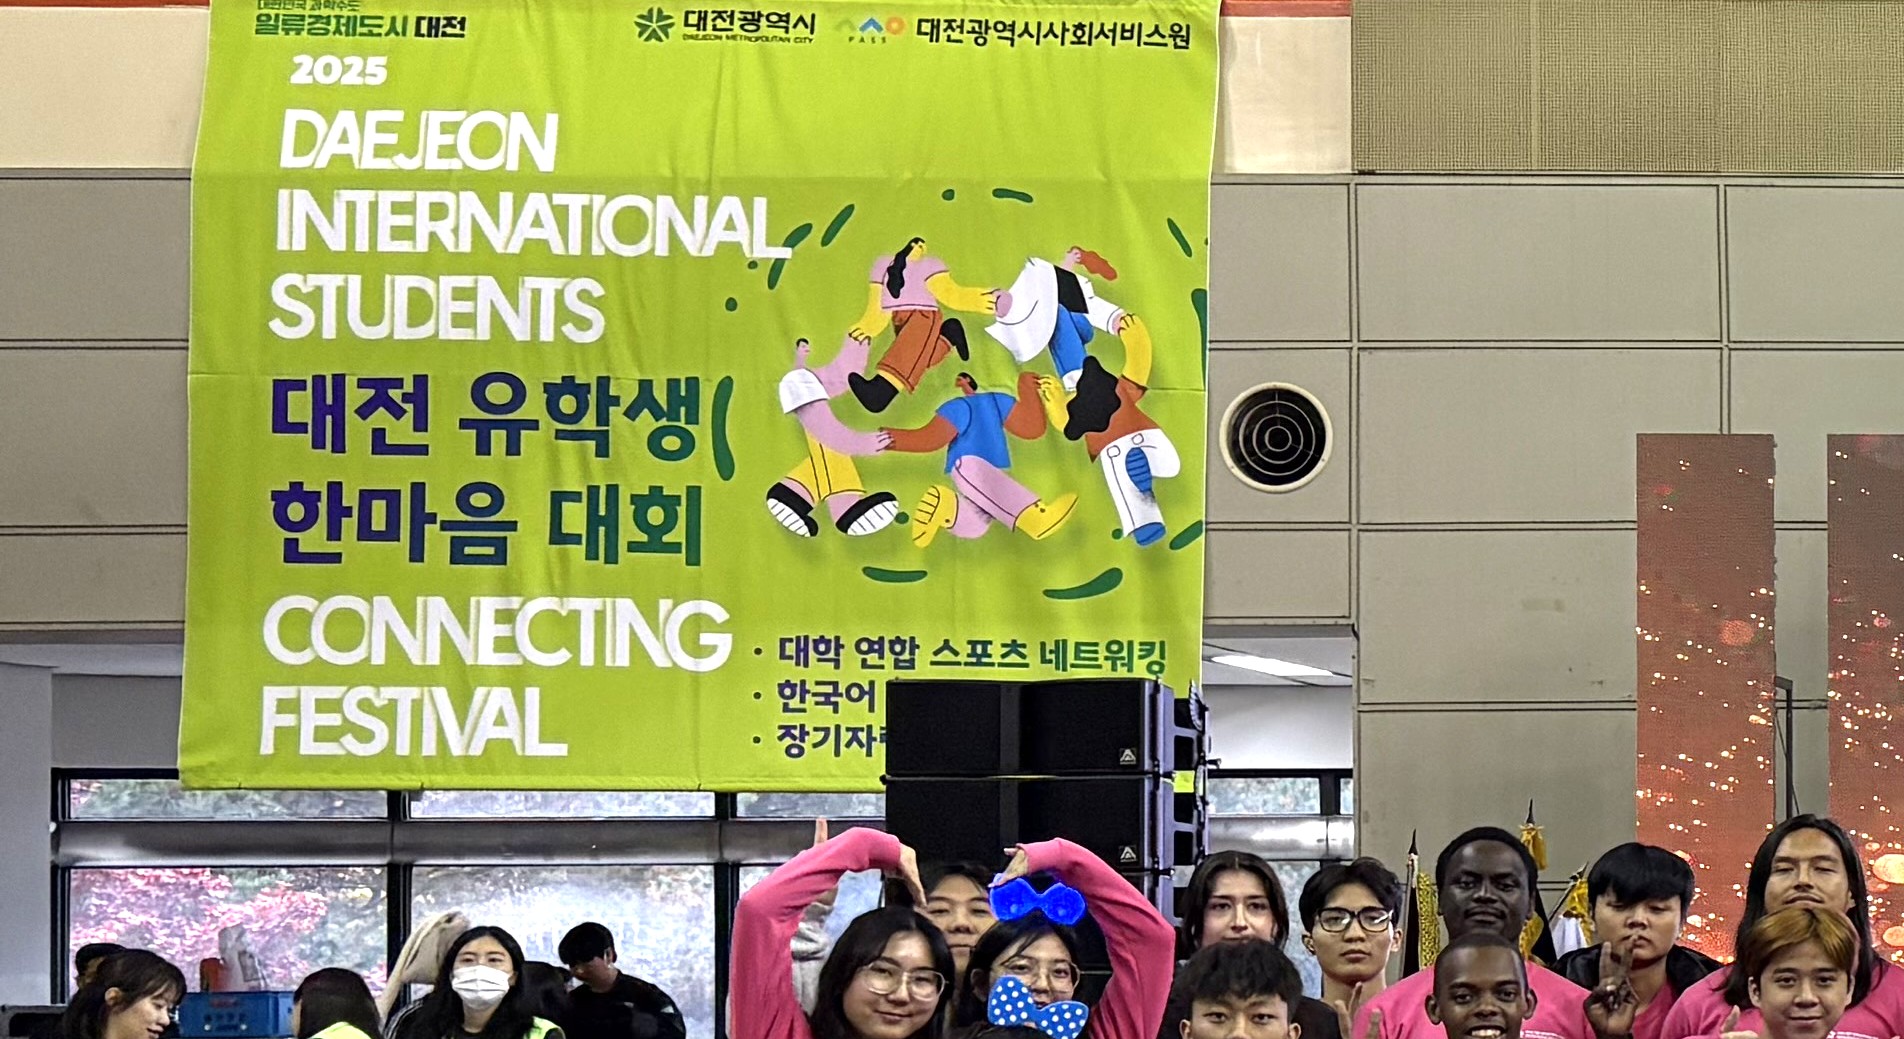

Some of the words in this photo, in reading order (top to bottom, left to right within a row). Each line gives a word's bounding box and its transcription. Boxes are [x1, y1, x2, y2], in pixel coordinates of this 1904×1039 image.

[254, 13, 408, 38] 일류경제도시
[414, 15, 466, 39] 대전
[683, 10, 816, 35] 대전광역시
[916, 17, 1191, 50] 대전광역시사회서비스원
[290, 54, 388, 86] 2025
[280, 108, 559, 172] DAEJEON
[276, 188, 792, 260] INTERNATIONAL
[268, 272, 606, 343] STUDENTS
[272, 373, 429, 457] 대전
[459, 371, 700, 462] 유학생
[271, 481, 518, 566] 한마음
[549, 484, 703, 566] 대회
[262, 594, 733, 673] CONNECTING
[778, 634, 845, 670] 대학
[854, 635, 921, 671] 연합
[929, 637, 1030, 670] 스포츠
[1039, 638, 1167, 676] 네트워킹
[259, 684, 568, 757] FESTIVAL
[776, 679, 876, 714] 한국어
[776, 722, 887, 758] 장기자
